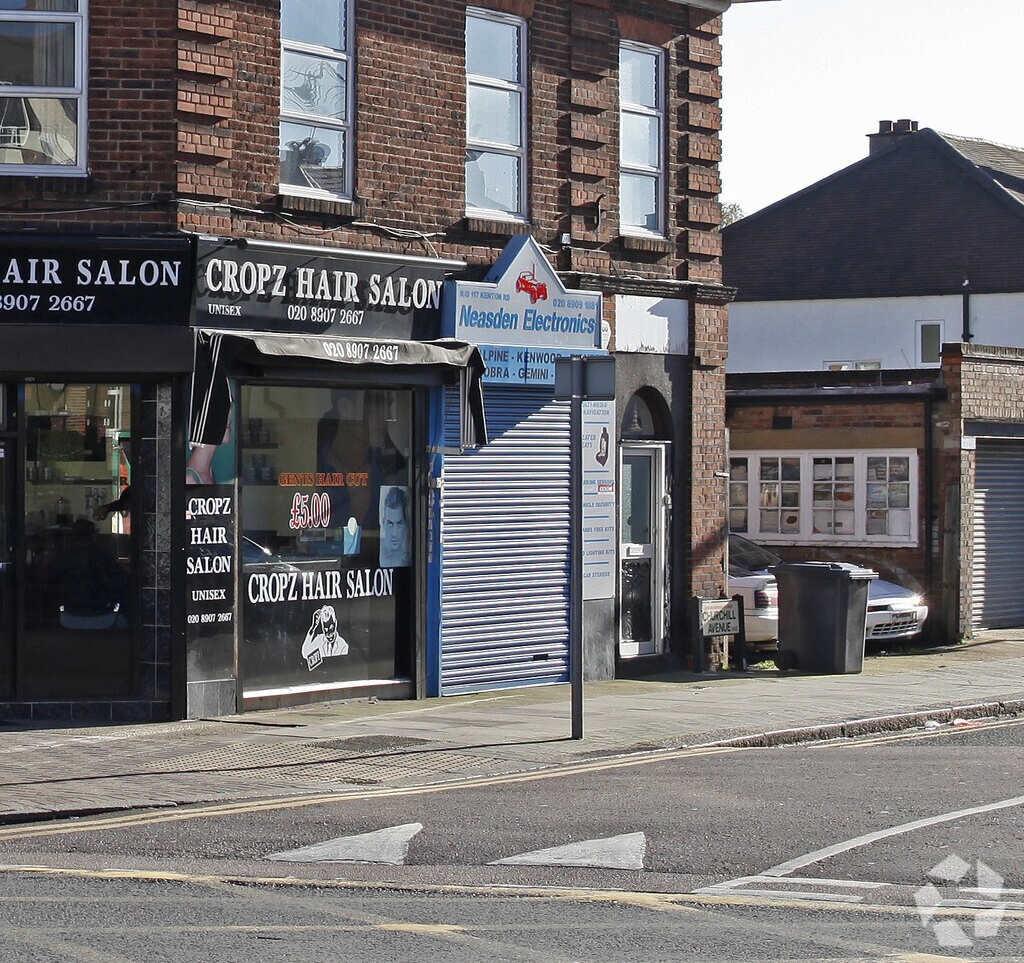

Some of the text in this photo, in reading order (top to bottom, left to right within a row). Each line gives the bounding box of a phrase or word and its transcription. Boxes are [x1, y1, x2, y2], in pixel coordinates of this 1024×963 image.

[77, 259, 181, 286] SALON
[205, 258, 443, 310] CROPZ HAIR SALON
[48, 295, 95, 312] 2667
[480, 292, 502, 300] KENTON
[553, 298, 565, 308] 020
[208, 303, 242, 316] UNISEX
[287, 305, 364, 325] 020 8907 2667
[459, 304, 518, 330] Neasden
[523, 308, 596, 335] Electronics
[323, 342, 399, 361] 020 8907 2667
[480, 350, 509, 363] LPINE
[518, 367, 549, 380] GEMINI
[279, 472, 369, 487] GENTS HAIR CUT
[188, 498, 231, 515] CROPZ
[289, 492, 330, 529] £5.00
[190, 526, 228, 545] HAIR
[186, 556, 232, 575] SALON
[248, 568, 393, 604] CROPZ HAIR SALON
[192, 589, 226, 601] UNISEX
[187, 612, 232, 624] 020 8907 2667
[703, 610, 736, 621] CHURCHILL
[708, 622, 731, 633] AVENUE
